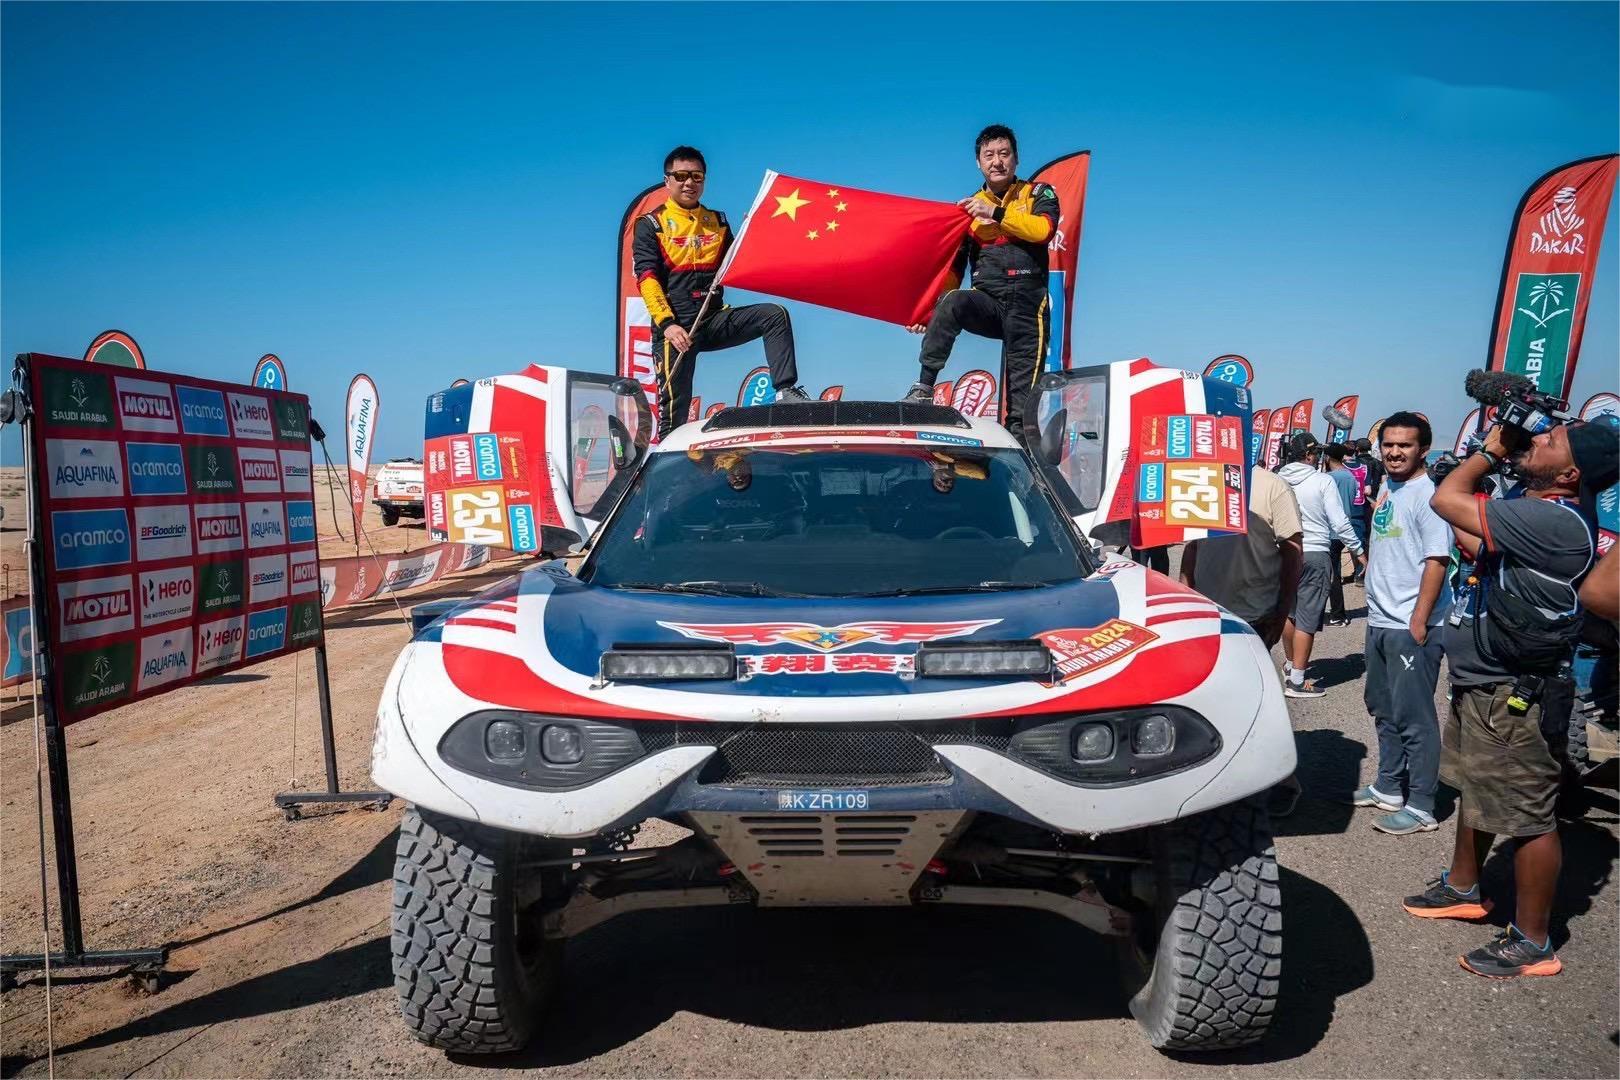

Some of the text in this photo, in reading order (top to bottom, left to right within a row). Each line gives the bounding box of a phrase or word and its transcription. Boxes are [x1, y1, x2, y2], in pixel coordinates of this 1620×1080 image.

[1529, 231, 1584, 254] DAKAR
[125, 395, 171, 416] MOTUL
[183, 403, 224, 420] aramco
[244, 405, 268, 421] Hero
[52, 410, 108, 423] SAUDI ARABIA
[353, 398, 371, 459] AQUAFINA
[1171, 418, 1187, 456] aramco
[1195, 420, 1213, 455] MOTUL
[695, 436, 753, 450] MOTUL
[920, 433, 977, 446] aramco
[452, 440, 473, 477] MOTUL
[479, 437, 497, 476] aramco
[56, 465, 119, 486] AQUAFINA
[131, 461, 181, 476] aramco
[245, 462, 277, 478] MOTUL
[196, 480, 213, 489] SAUDI
[1146, 464, 1157, 500] aramco
[1170, 466, 1219, 521] 254
[431, 493, 444, 526] MOTUL
[452, 490, 504, 545] 254
[1228, 492, 1241, 527] MOTUL
[60, 528, 125, 548] aramco
[141, 524, 187, 537] BFGoodrich
[200, 519, 239, 537] MOTUL
[251, 521, 282, 538] AQUAFINA
[515, 507, 530, 549] aramco
[158, 579, 192, 600] Hero
[67, 594, 129, 621] MOTUL
[213, 627, 242, 648] Hero
[248, 622, 284, 641] aramco
[1083, 623, 1133, 649] 2024
[1086, 638, 1135, 663] ARABIA
[143, 651, 187, 678] AQUAFINA
[75, 682, 125, 704] SAUDI ARABIA
